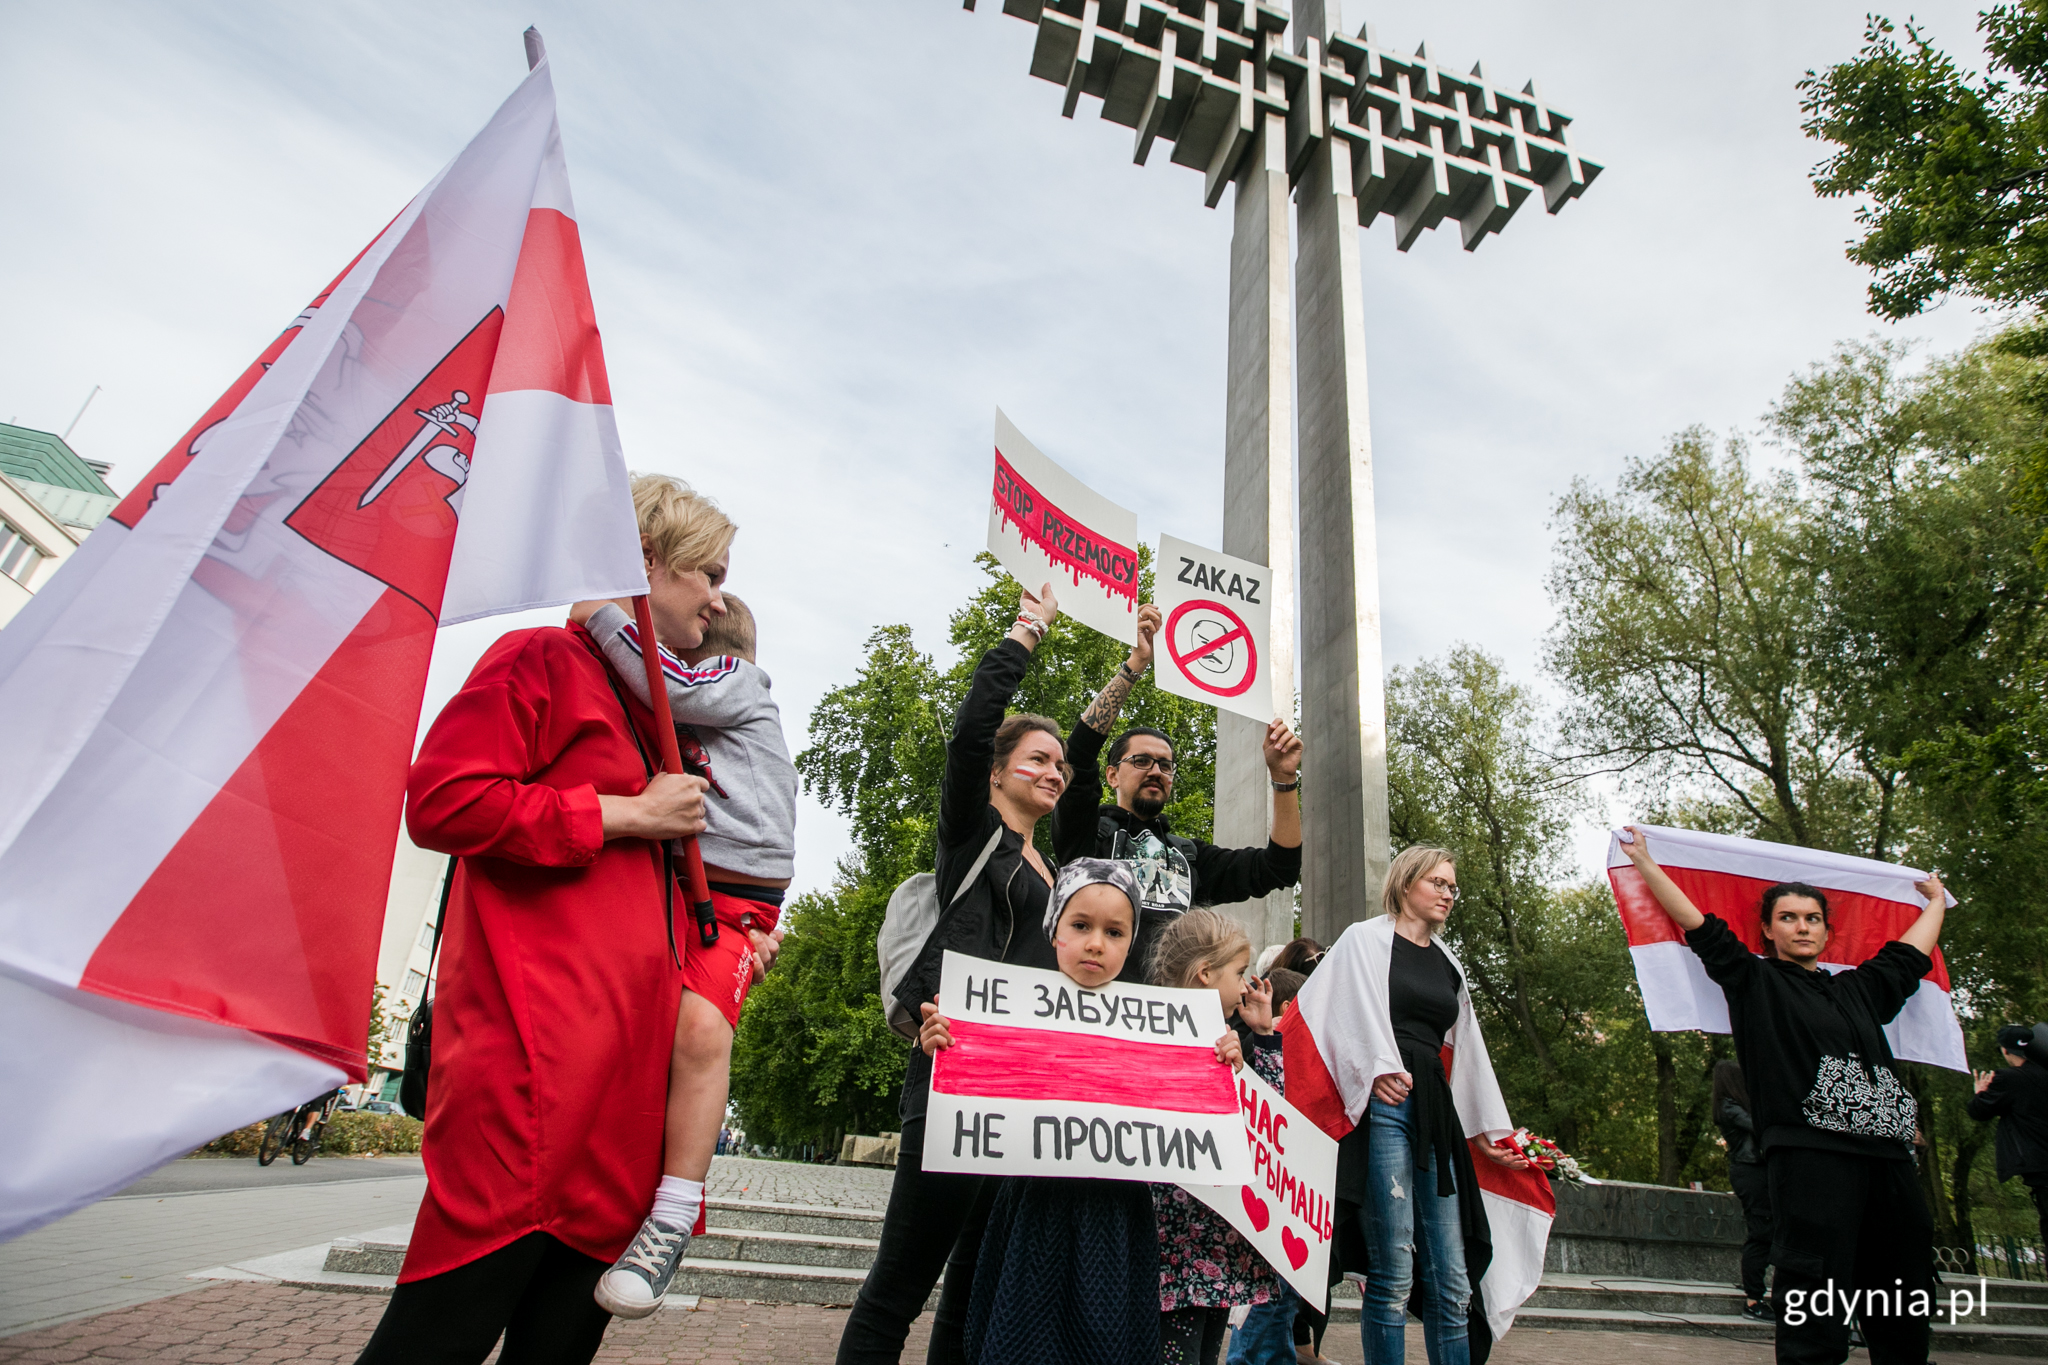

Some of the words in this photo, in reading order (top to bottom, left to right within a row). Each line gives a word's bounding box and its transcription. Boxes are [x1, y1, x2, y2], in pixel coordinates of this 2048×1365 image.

[996, 465, 1033, 519] STOP
[1042, 509, 1135, 584] PRZEMOCY
[1178, 556, 1261, 604] ZAKAZ
[966, 975, 1010, 1014] НЕ
[1034, 984, 1198, 1037] ЗАБУДЕМ
[953, 1110, 1005, 1158] НЕ
[1034, 1116, 1222, 1170] ПРОСТИМ
[1240, 1078, 1288, 1155] НАС
